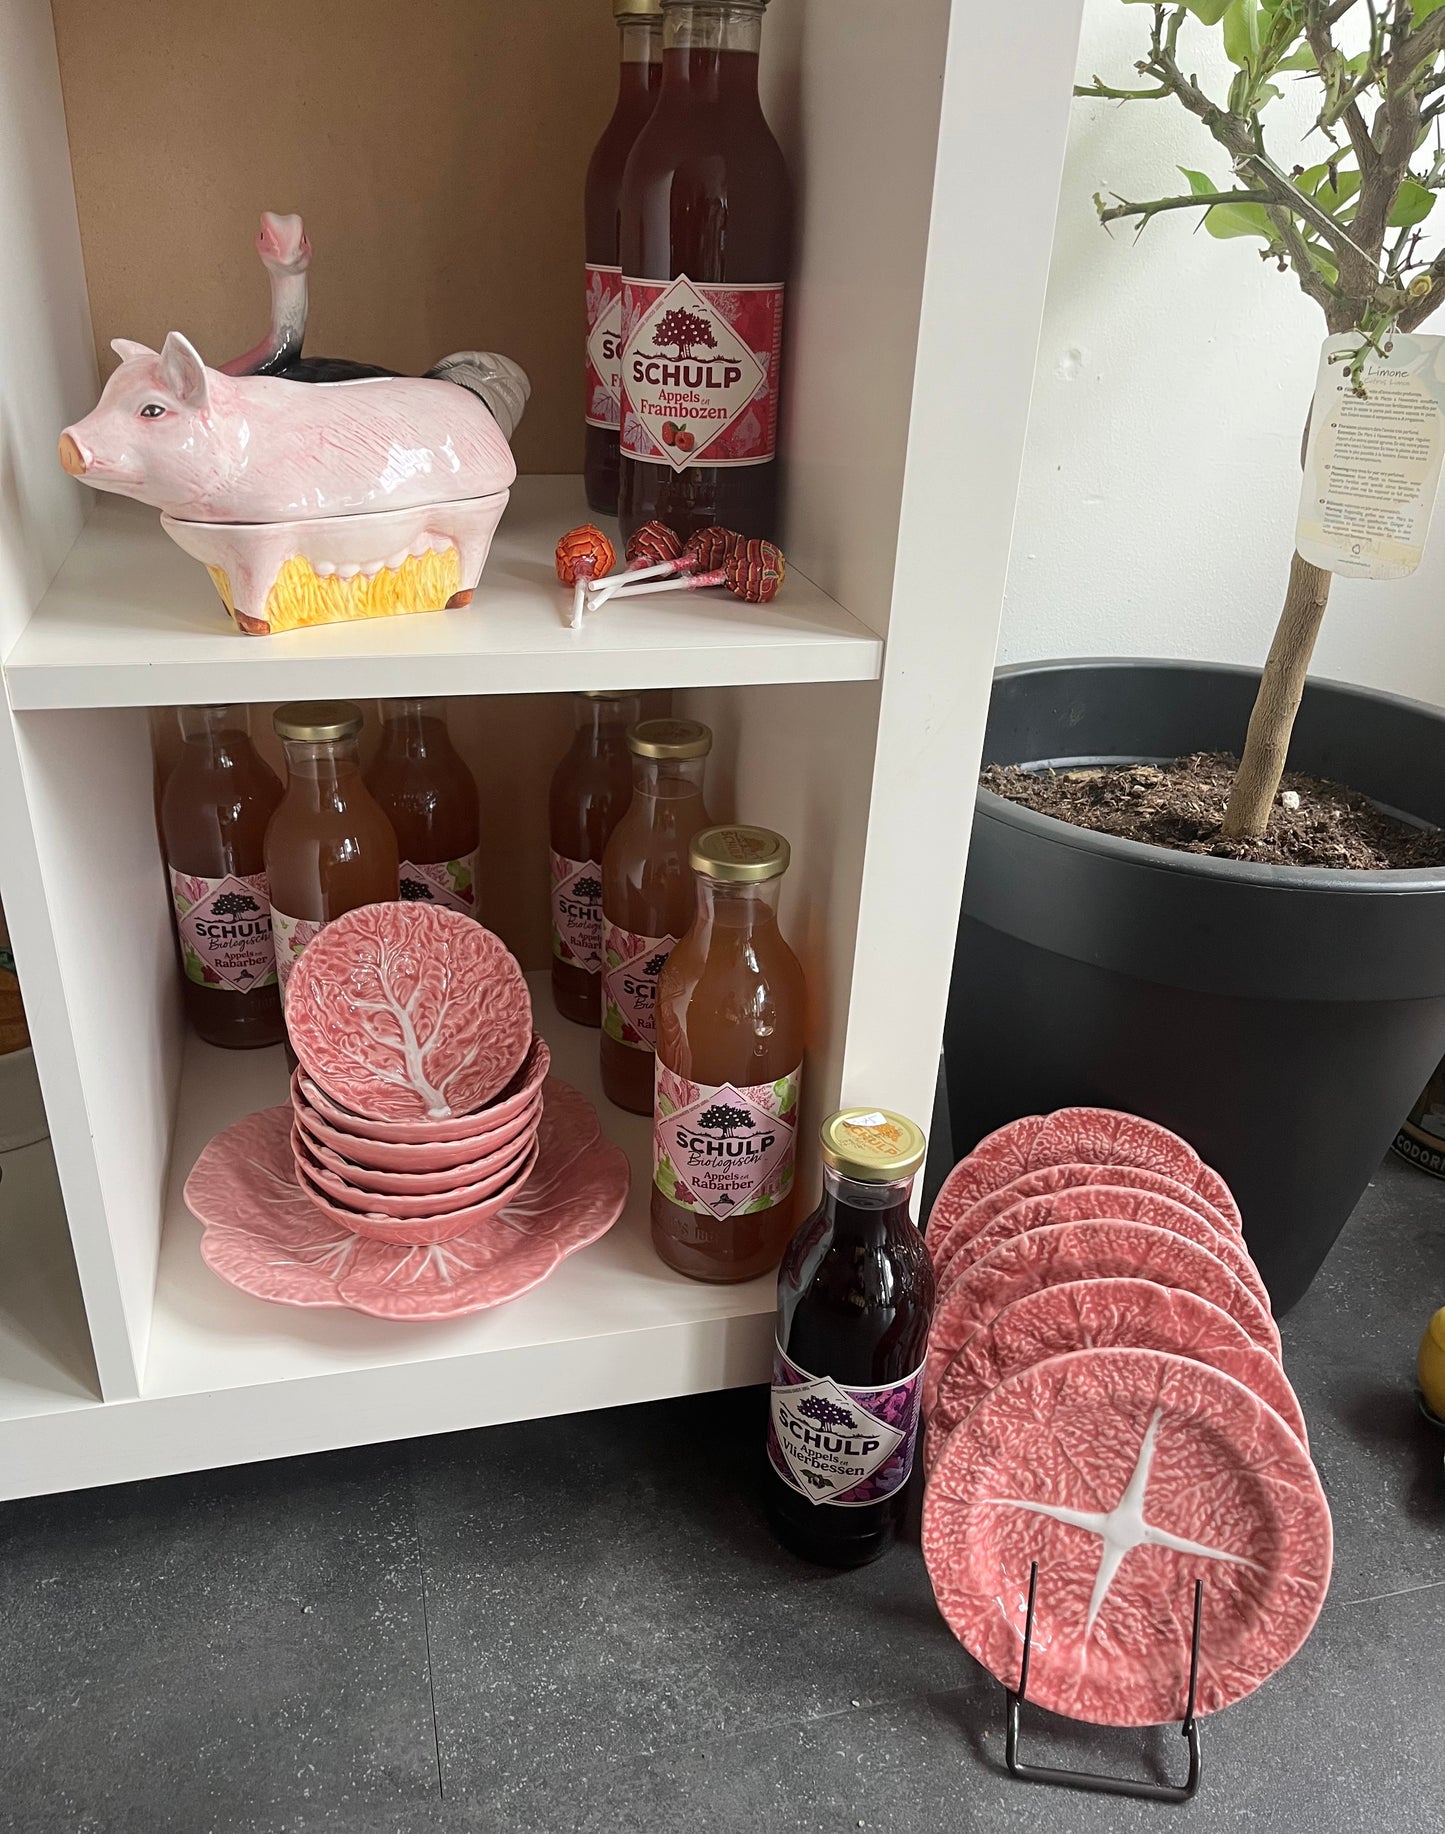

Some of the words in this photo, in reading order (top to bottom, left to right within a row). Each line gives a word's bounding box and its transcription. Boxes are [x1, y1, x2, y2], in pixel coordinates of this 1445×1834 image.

[632, 360, 742, 388] SCHULP
[1368, 366, 1410, 378] Limone
[658, 389, 700, 403] Appels
[640, 399, 728, 419] Frambozen
[214, 956, 268, 968] Rabarber
[224, 951, 254, 960] Appels
[676, 1131, 775, 1157] SCHULP
[687, 1151, 762, 1173] Biologisch
[691, 1176, 754, 1190] Rabarber
[703, 1171, 739, 1181] Appels
[778, 1409, 880, 1456] SCHULP
[782, 1436, 865, 1476] Vlierbessen
[800, 1444, 839, 1463] Appels
